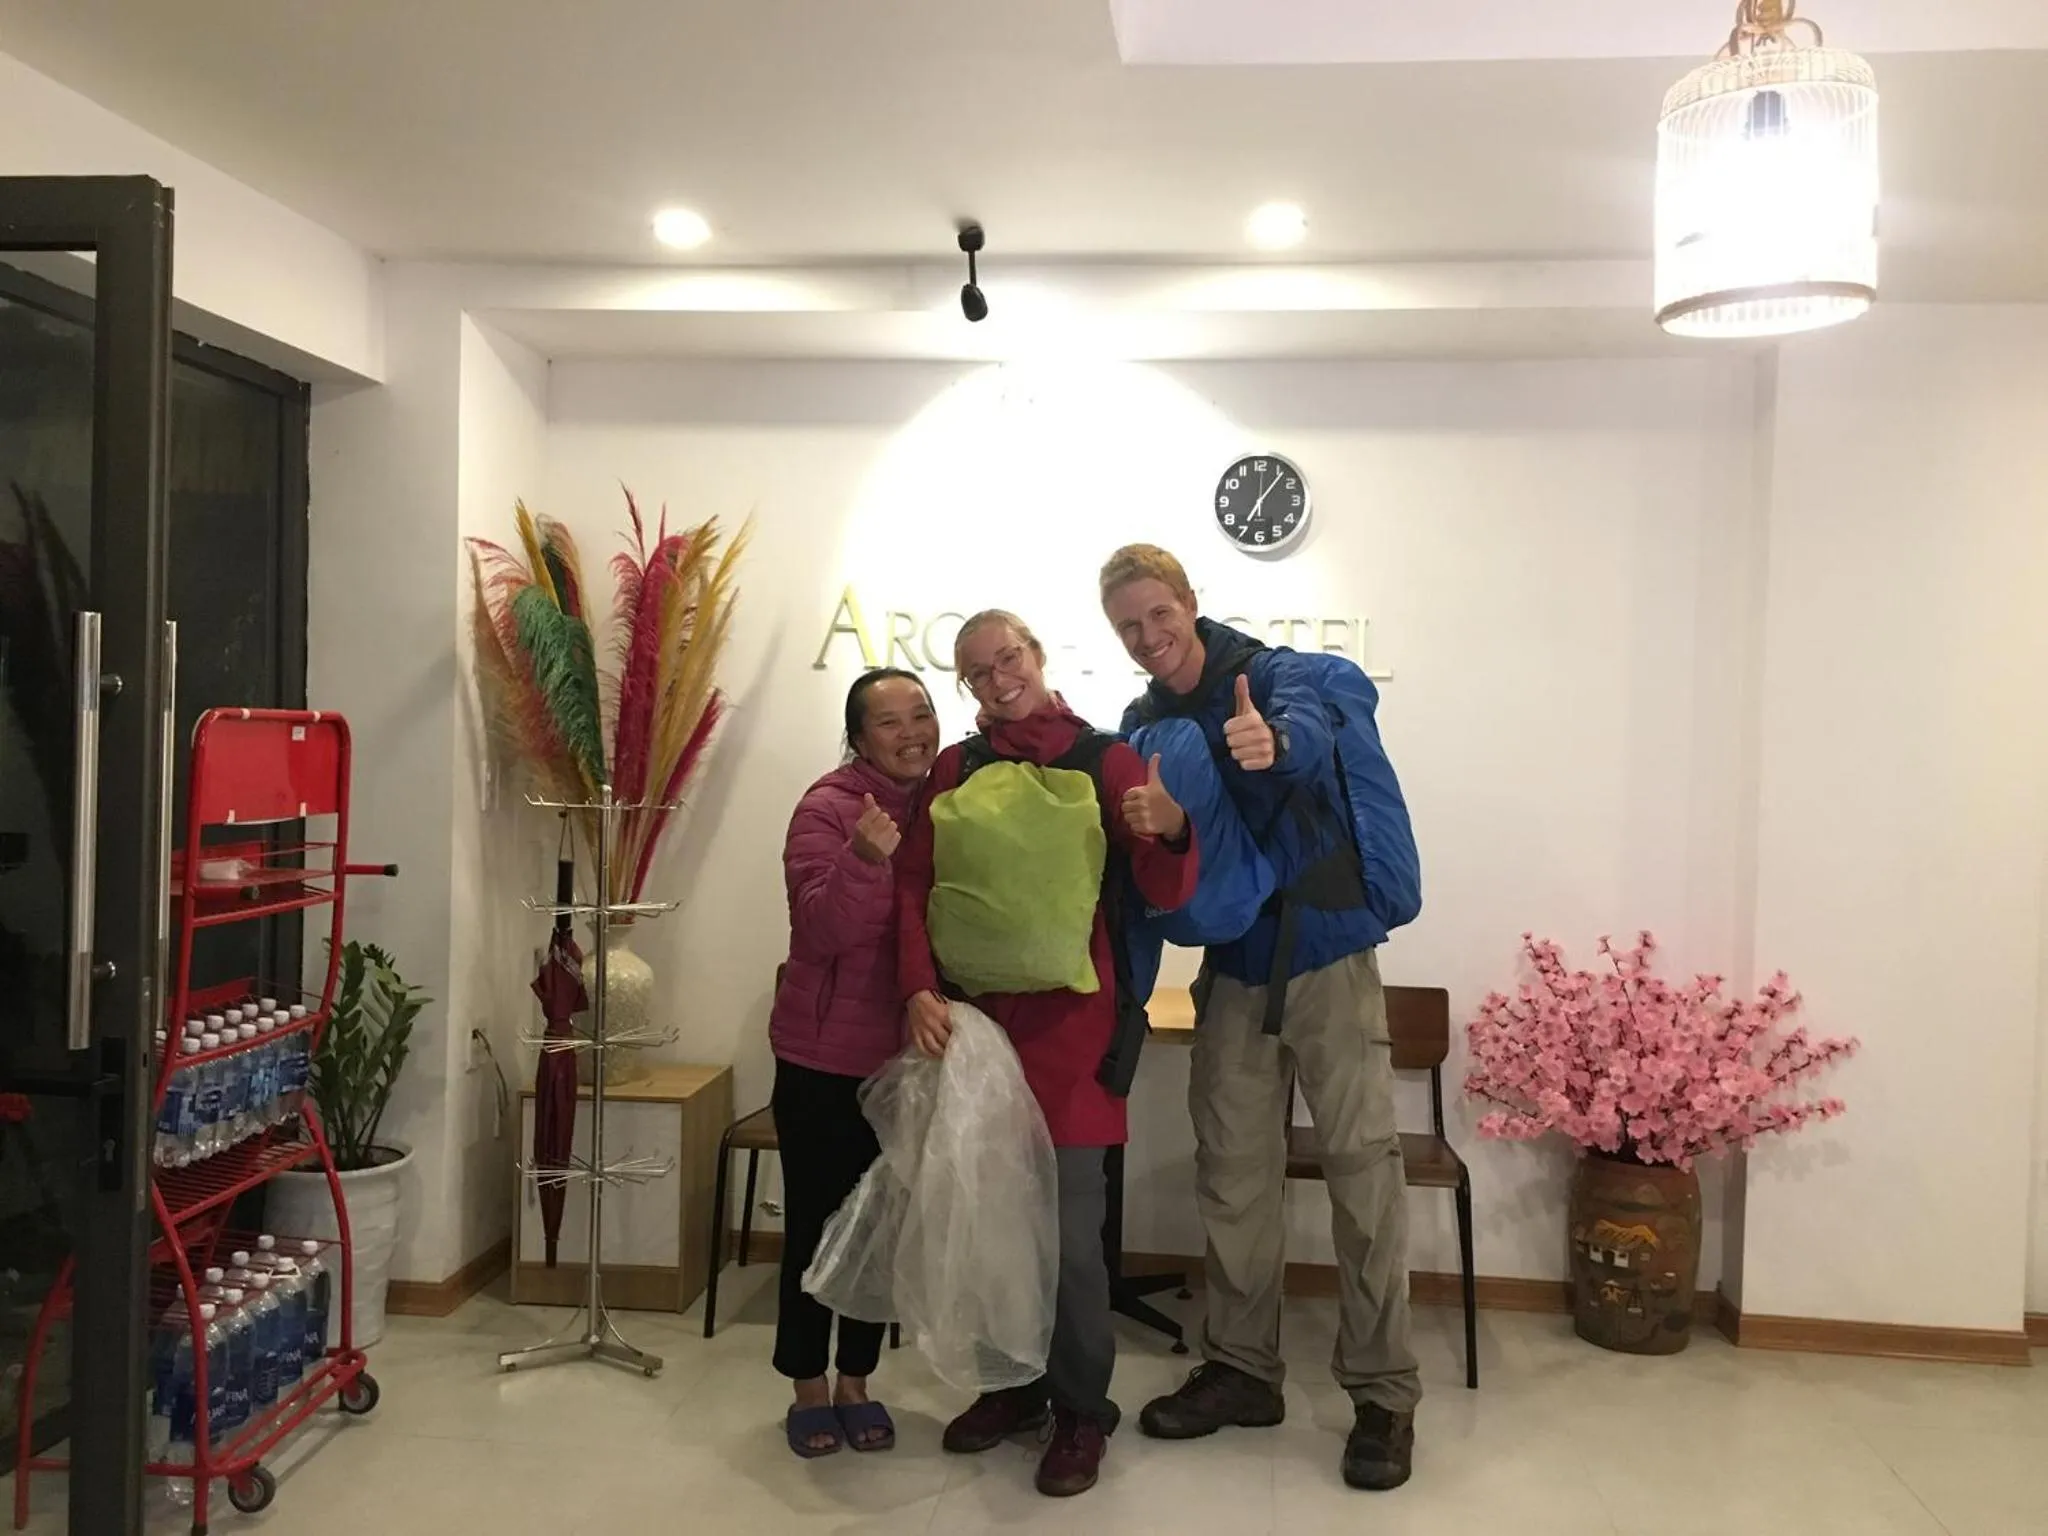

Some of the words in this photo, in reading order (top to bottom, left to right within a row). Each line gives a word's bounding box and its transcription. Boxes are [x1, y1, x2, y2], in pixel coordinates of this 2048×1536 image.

[1239, 465, 1247, 477] 11
[1254, 460, 1268, 472] 12
[1225, 478, 1239, 490] 10
[1285, 478, 1296, 489] 2
[1219, 496, 1230, 508] 9
[1291, 495, 1301, 506] 3
[1224, 513, 1235, 526] 8
[1284, 512, 1295, 524] 4
[1254, 531, 1265, 543] 6
[1272, 525, 1282, 537] 5
